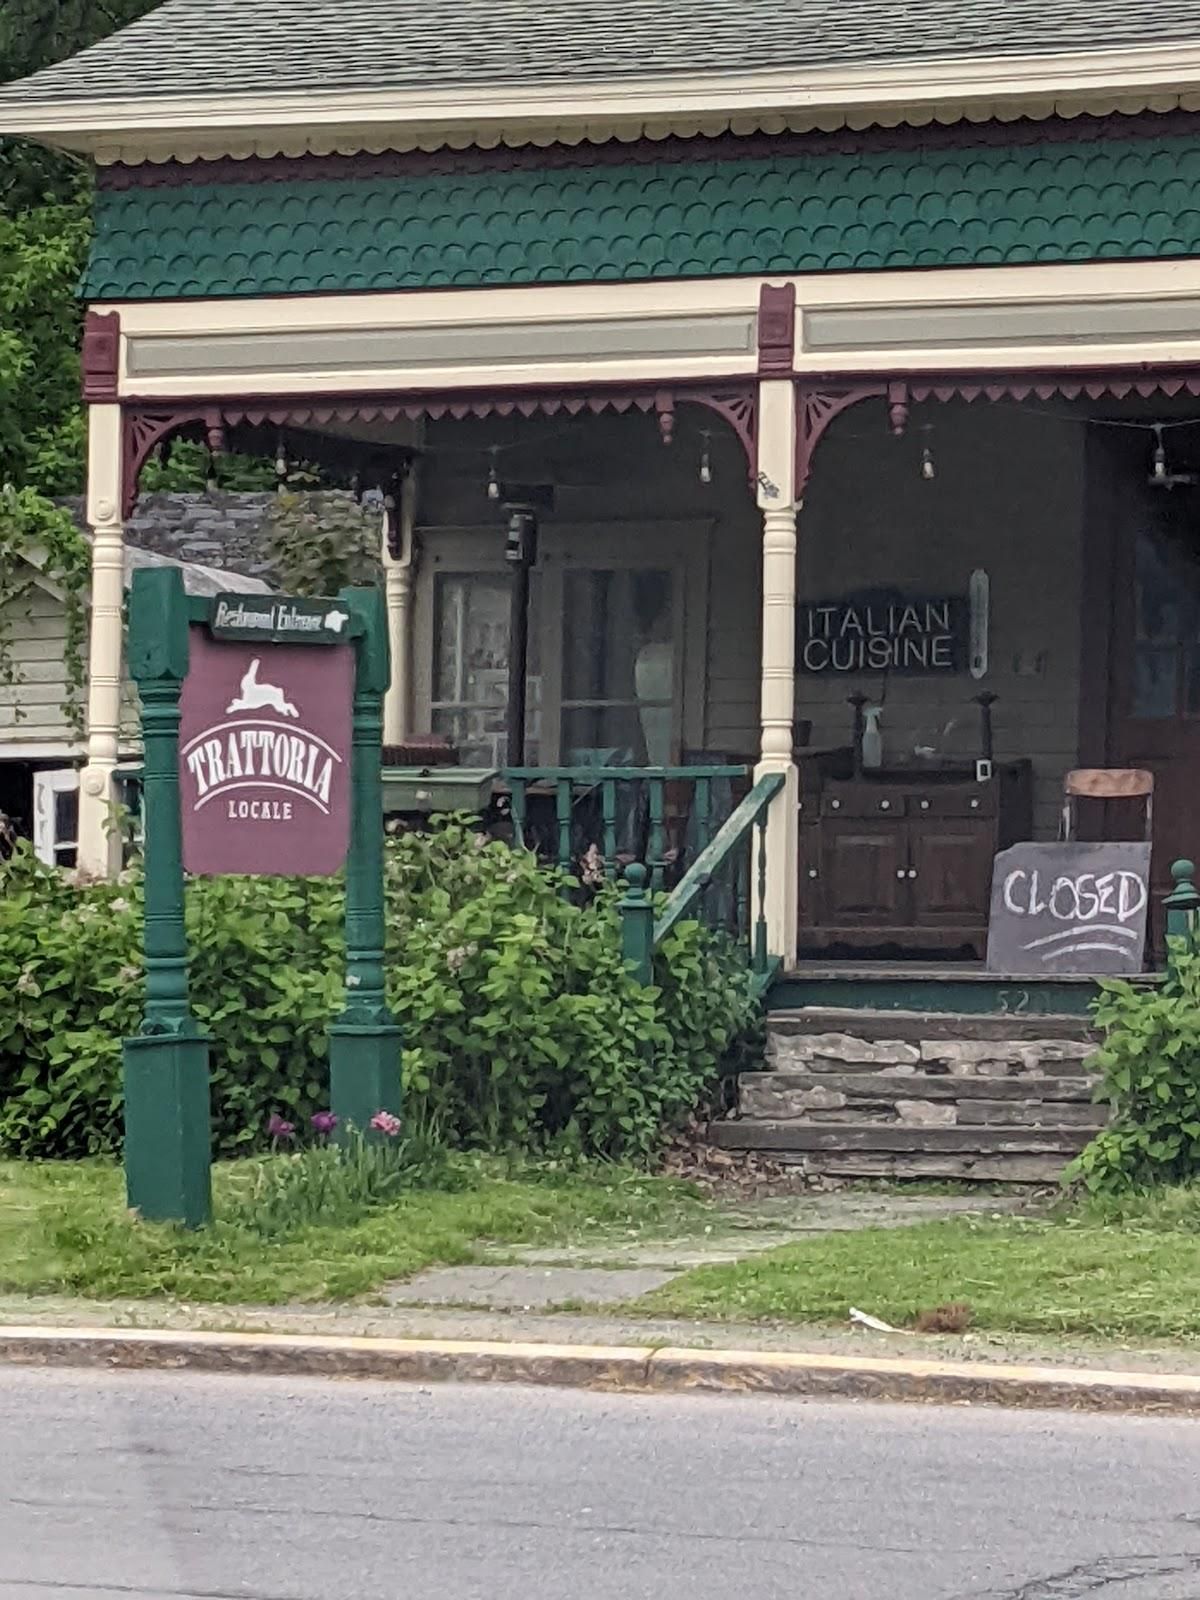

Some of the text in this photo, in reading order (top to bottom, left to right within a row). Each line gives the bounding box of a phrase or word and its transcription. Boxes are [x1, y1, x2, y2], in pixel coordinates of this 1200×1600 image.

[215, 601, 322, 631] Restt Entr
[808, 603, 949, 637] ITALIAN
[804, 635, 951, 670] CUISINE
[187, 730, 332, 804] TRATTORIA
[228, 800, 292, 820] LOCALE
[1004, 870, 1148, 922] CLOSED
